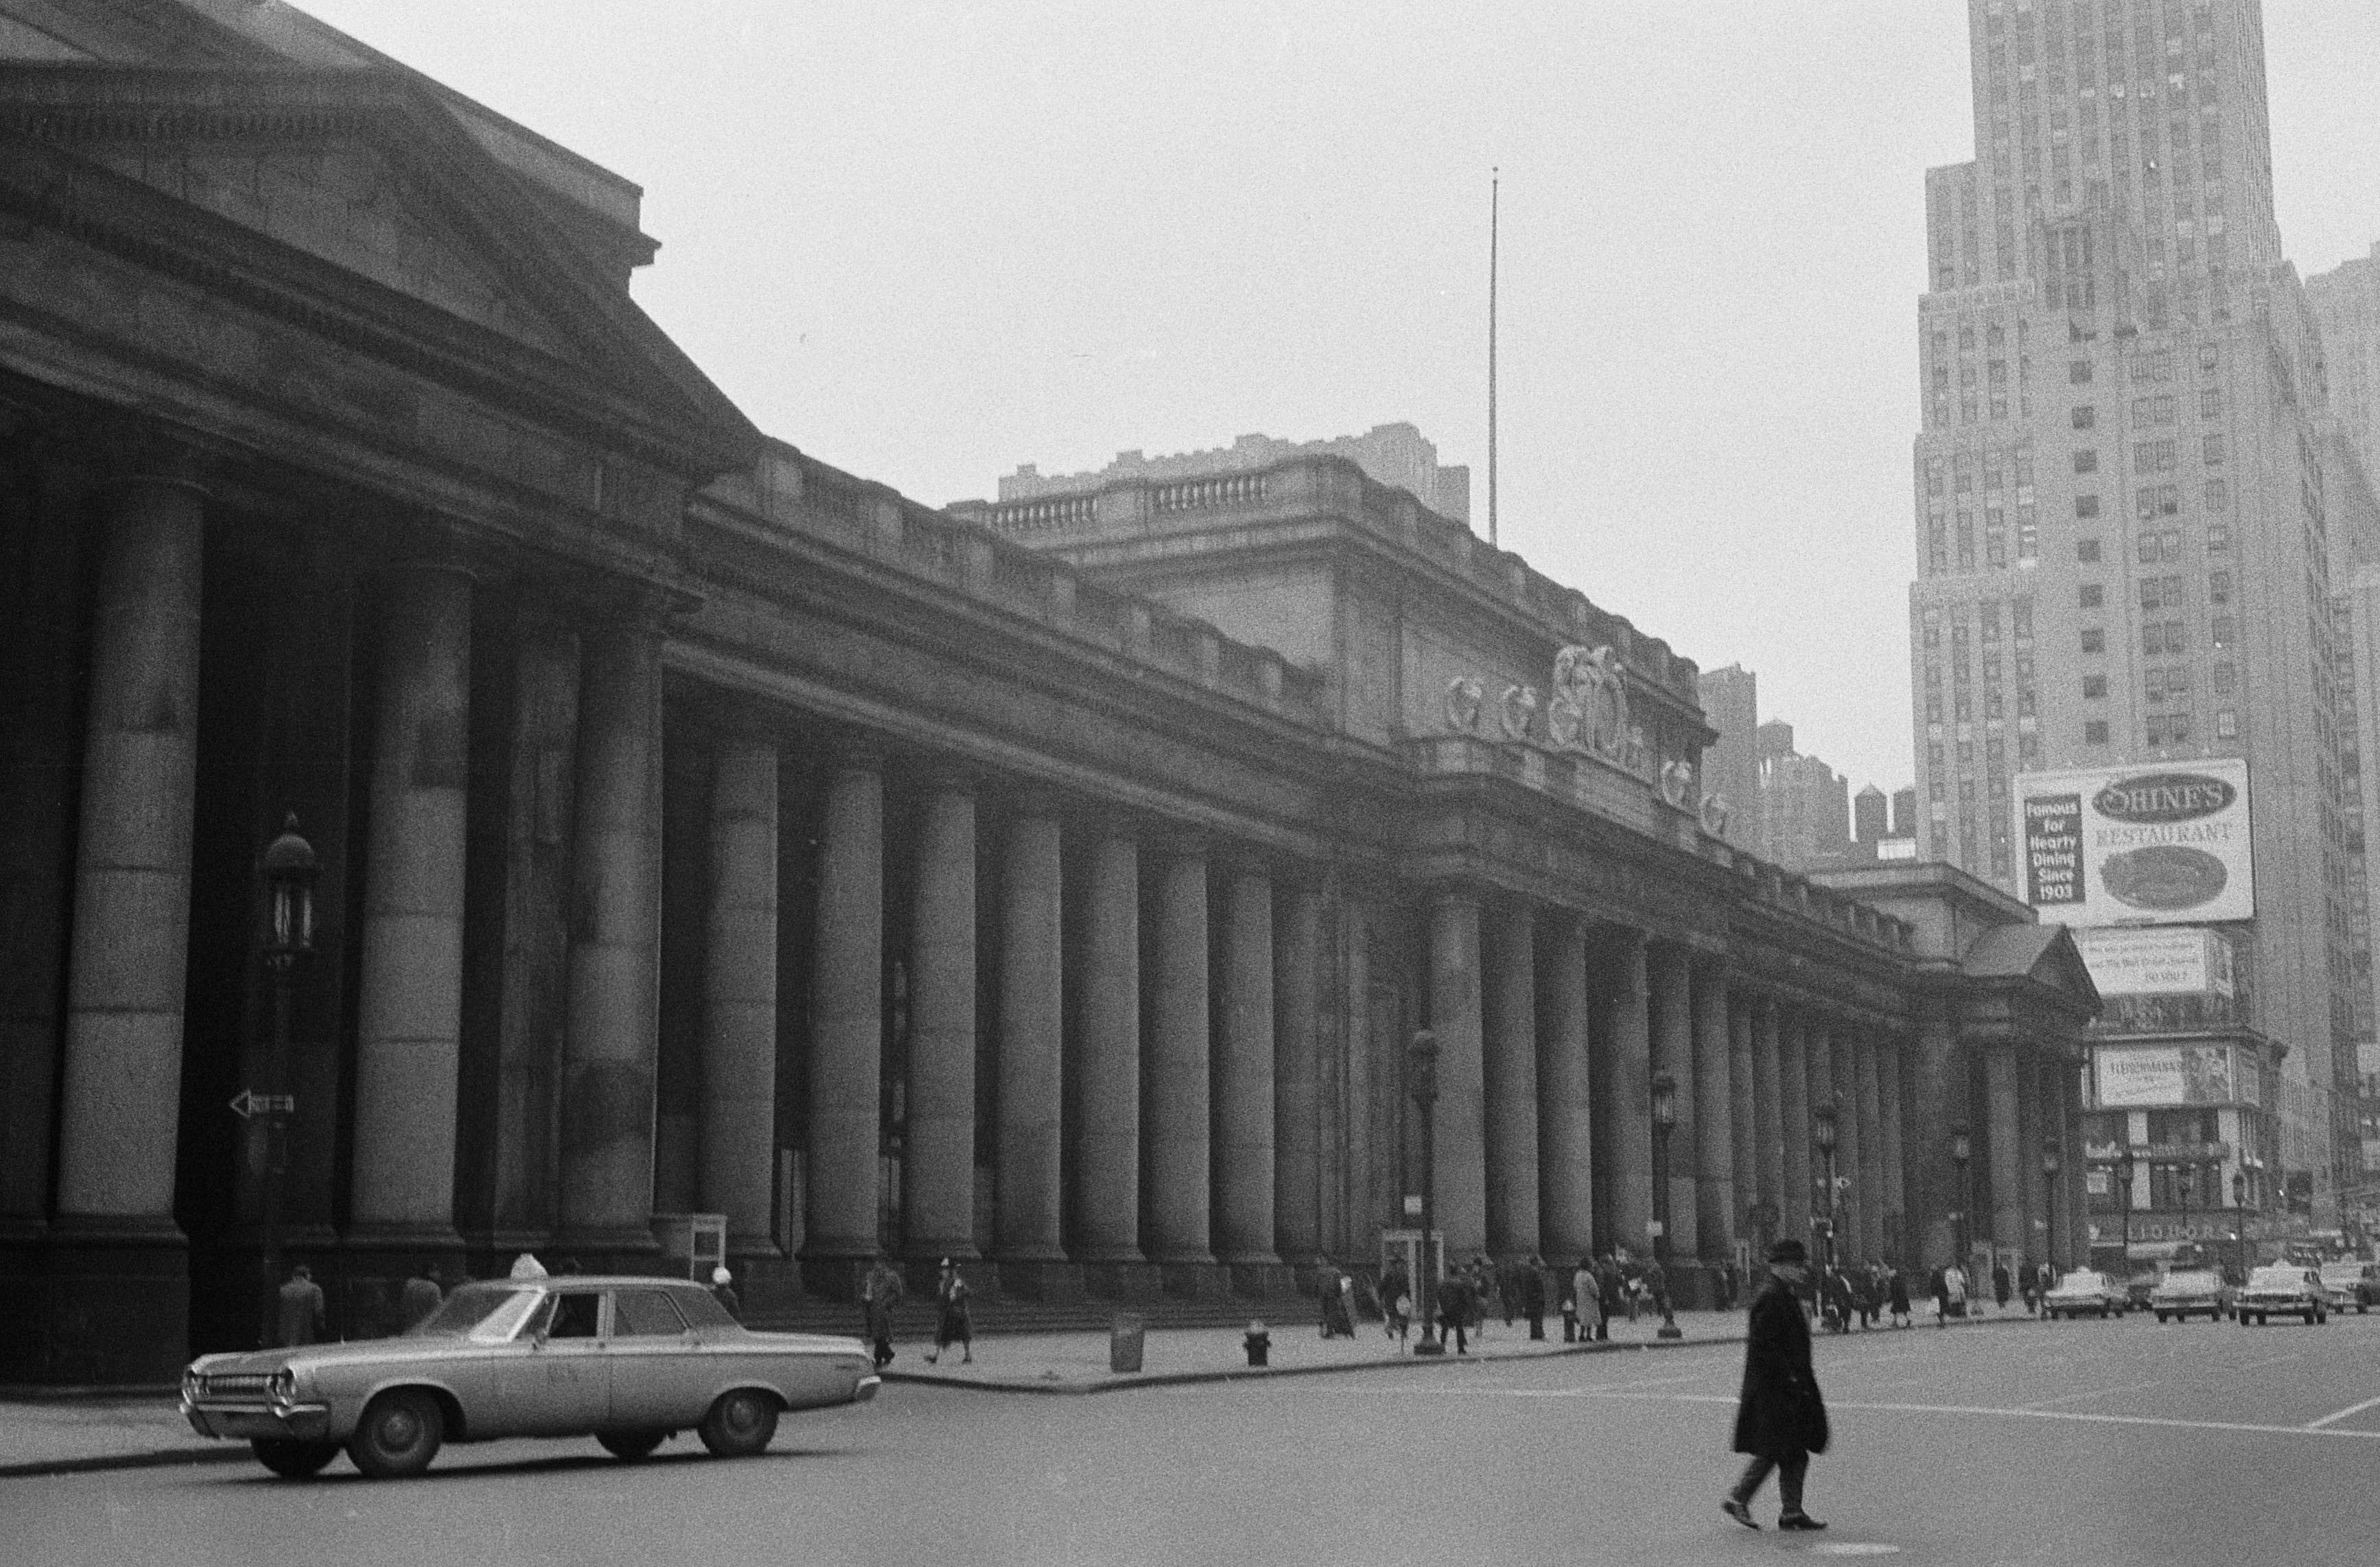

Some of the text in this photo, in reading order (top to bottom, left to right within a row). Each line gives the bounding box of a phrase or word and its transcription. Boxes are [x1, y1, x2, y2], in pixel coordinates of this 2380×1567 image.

[2101, 781, 2225, 815] SHINE'S
[2026, 802, 2079, 818] Famous
[2044, 817, 2066, 833] for
[2029, 835, 2077, 852] Hearty
[2096, 822, 2233, 848] RESTAURANT
[2033, 851, 2076, 869] Dining
[2038, 867, 2075, 883] Since
[2127, 1223, 2230, 1240] LIQUORS
